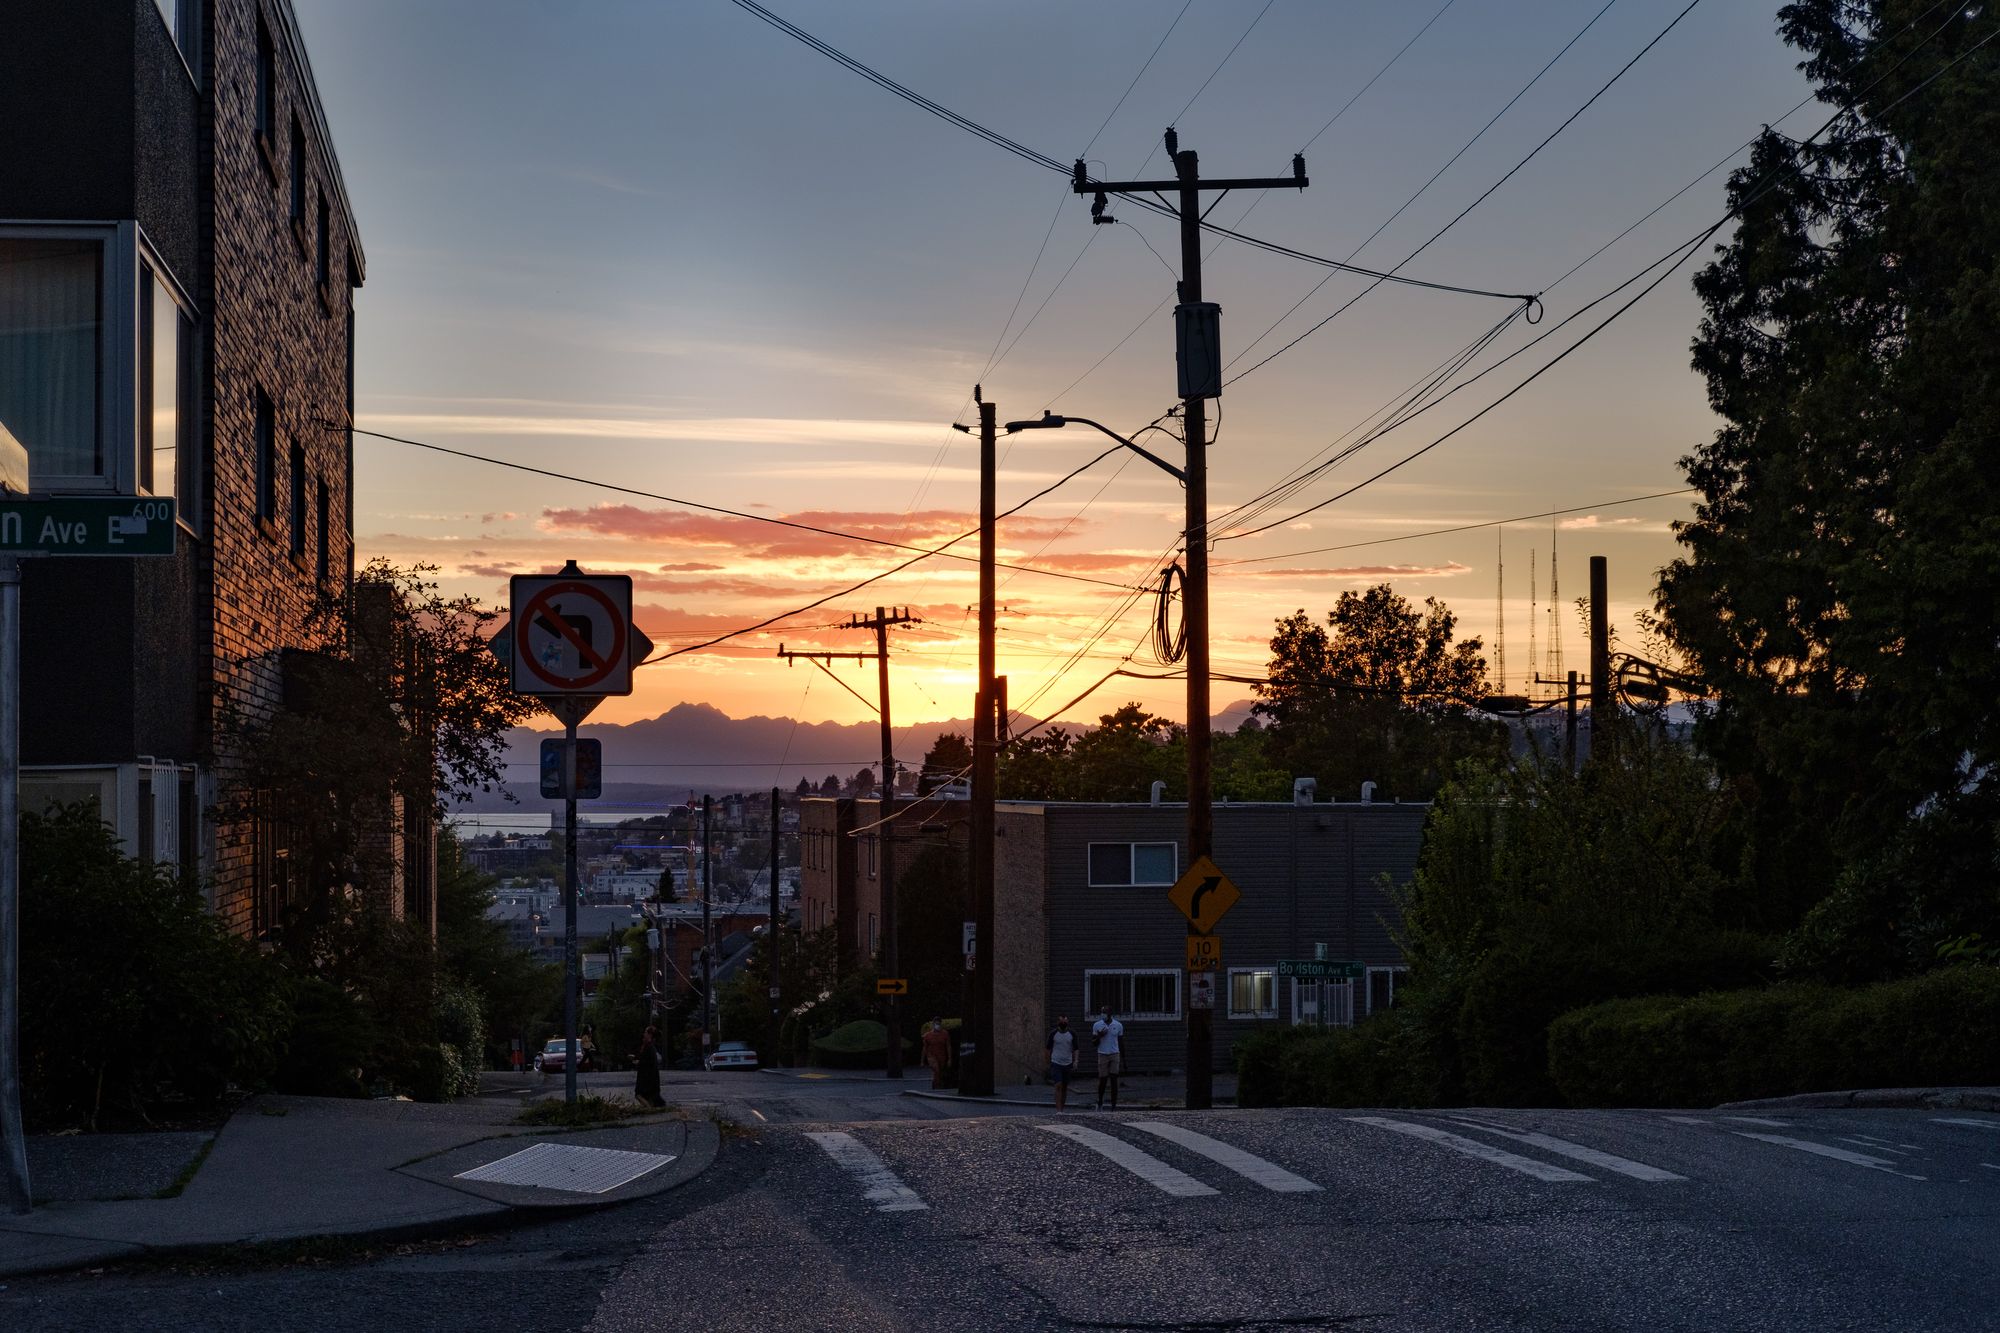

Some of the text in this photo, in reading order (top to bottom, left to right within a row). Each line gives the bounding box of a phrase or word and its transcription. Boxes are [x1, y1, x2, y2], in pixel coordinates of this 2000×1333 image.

[132, 502, 168, 520] 600
[38, 515, 87, 544] Ave
[108, 515, 125, 544] E
[1196, 941, 1211, 954] 10
